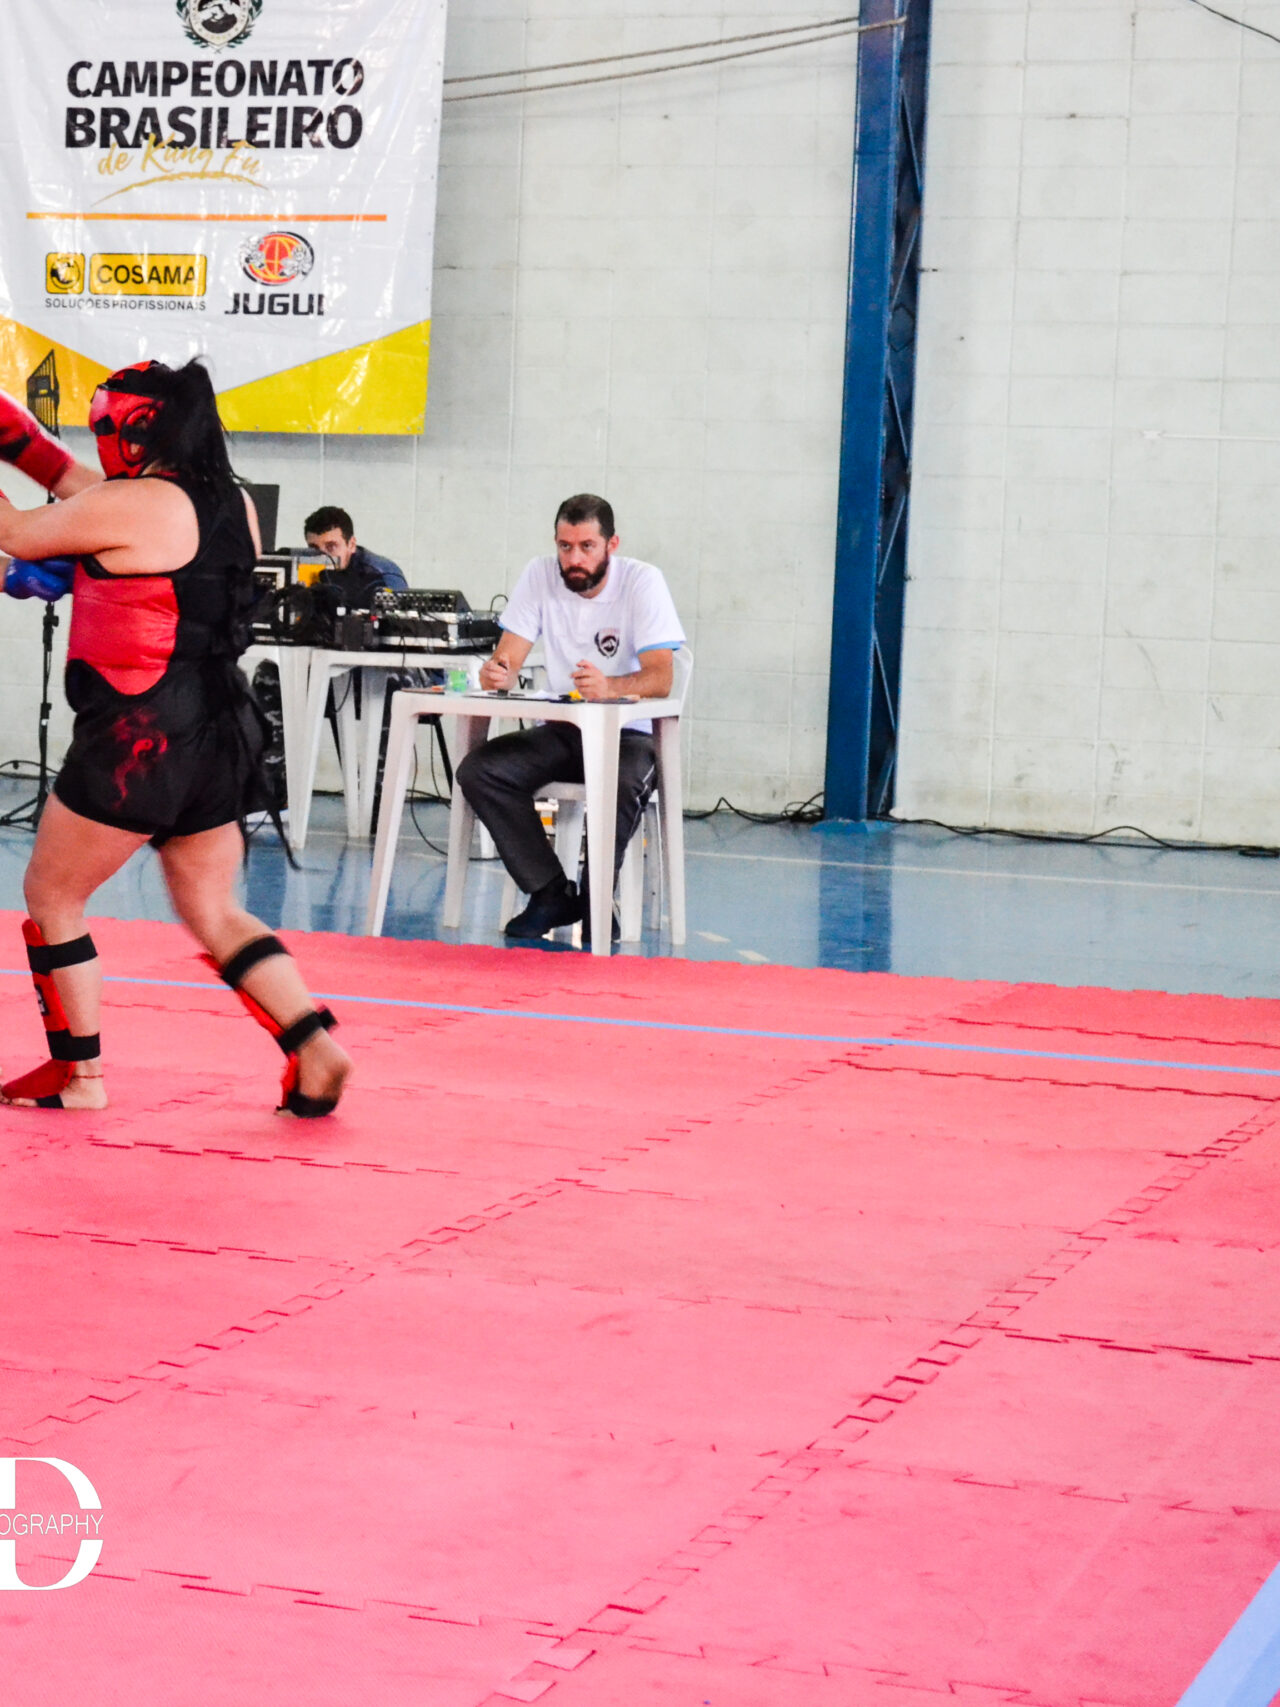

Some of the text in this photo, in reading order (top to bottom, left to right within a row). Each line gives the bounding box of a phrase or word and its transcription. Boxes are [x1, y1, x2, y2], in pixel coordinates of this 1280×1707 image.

[67, 57, 364, 98] CAMPEONATO
[65, 104, 363, 150] BRASILEIRO
[98, 132, 261, 178] de Kung Fu
[96, 263, 196, 285] COSAMA
[224, 292, 324, 316] JUGUI
